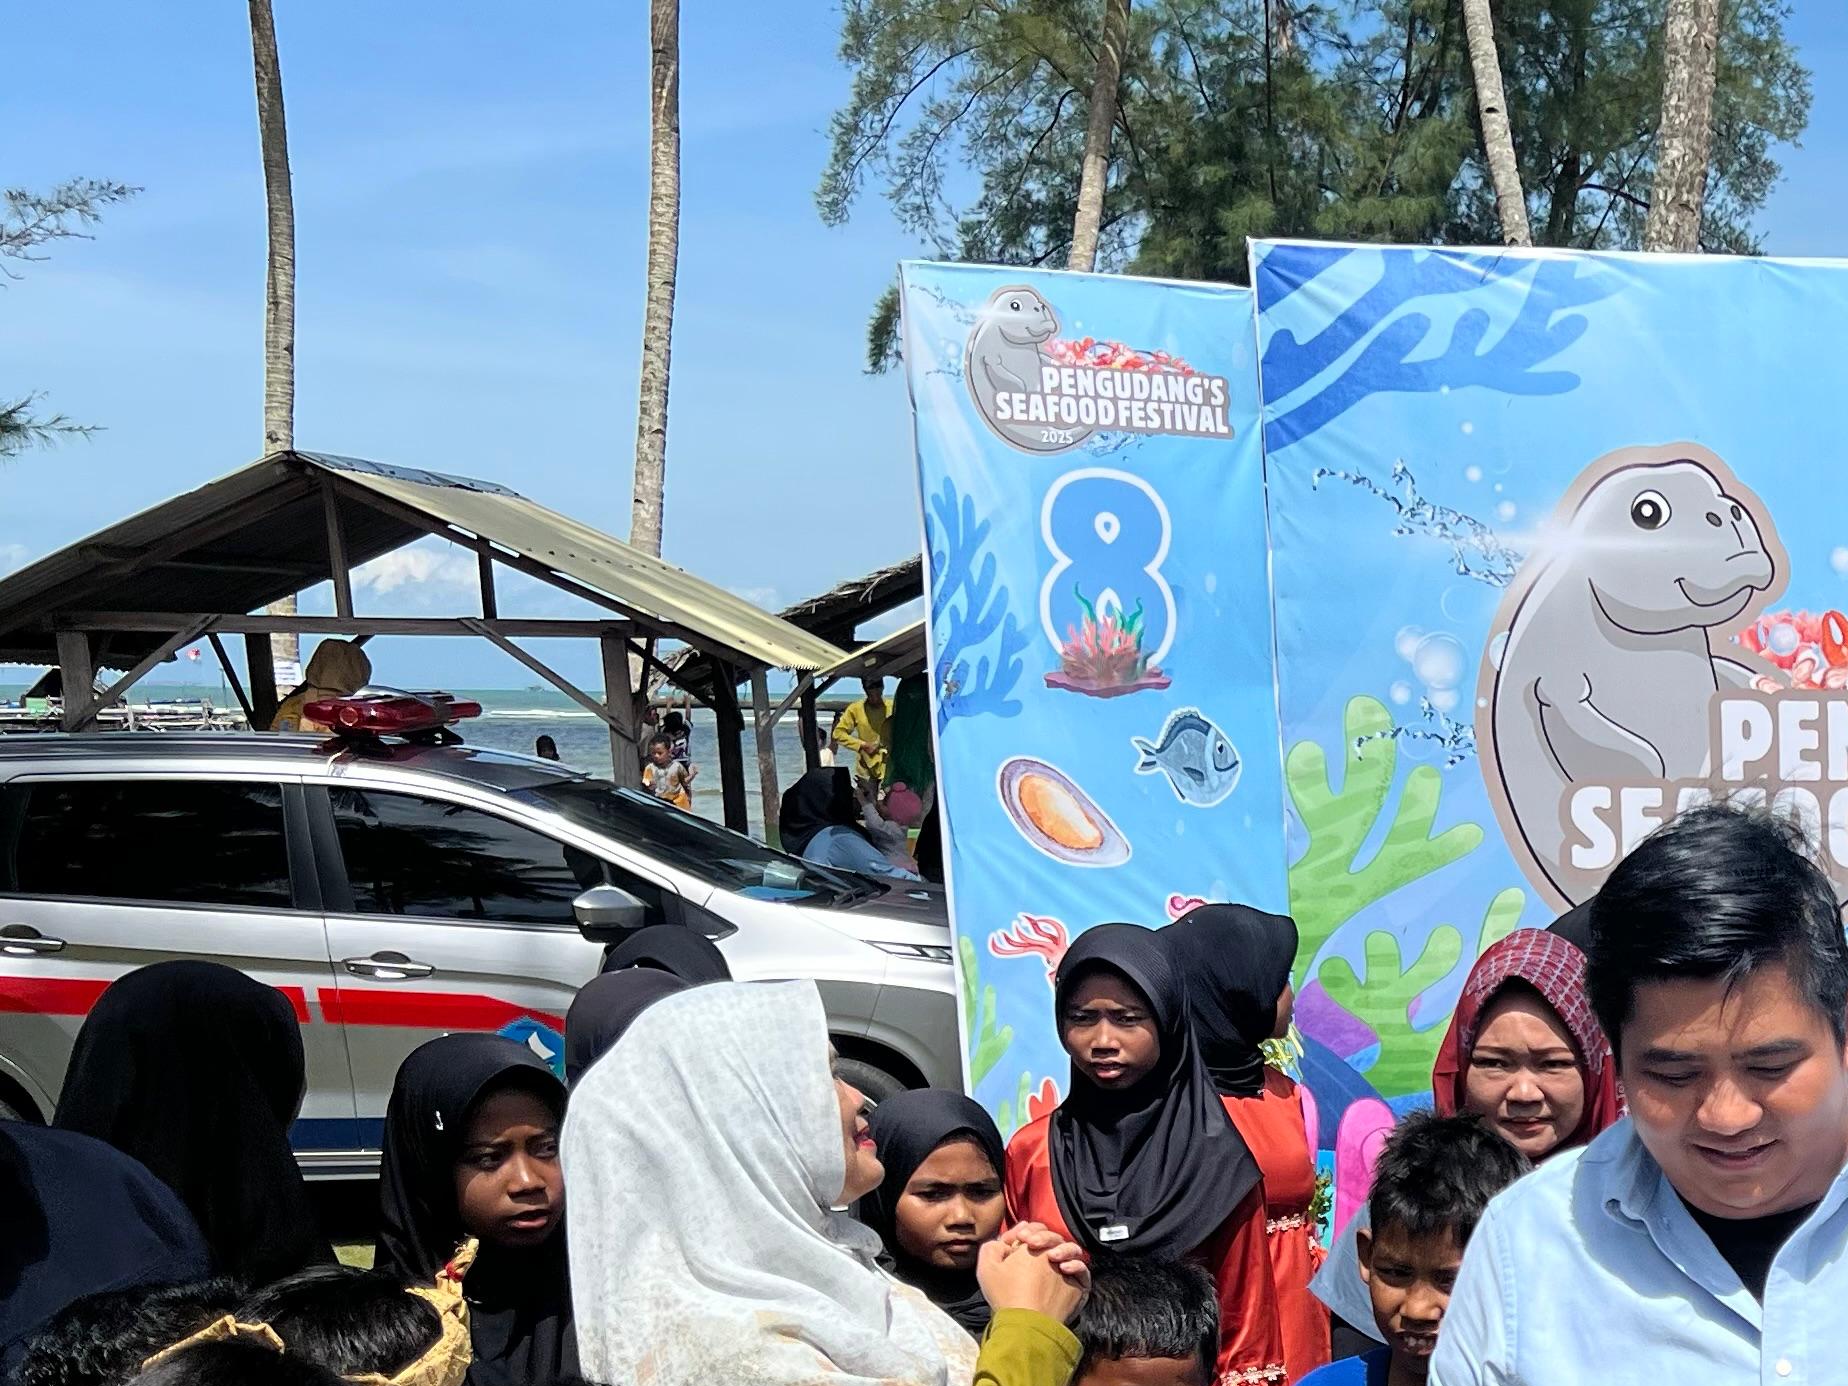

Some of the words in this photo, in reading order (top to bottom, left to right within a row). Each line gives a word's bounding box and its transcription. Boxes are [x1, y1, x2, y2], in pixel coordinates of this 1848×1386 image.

[1041, 366, 1225, 406] PENGUDANG'S
[995, 392, 1117, 426] SEAFOOD
[1117, 400, 1230, 434] FESTIVAL
[1041, 430, 1074, 445] 2025
